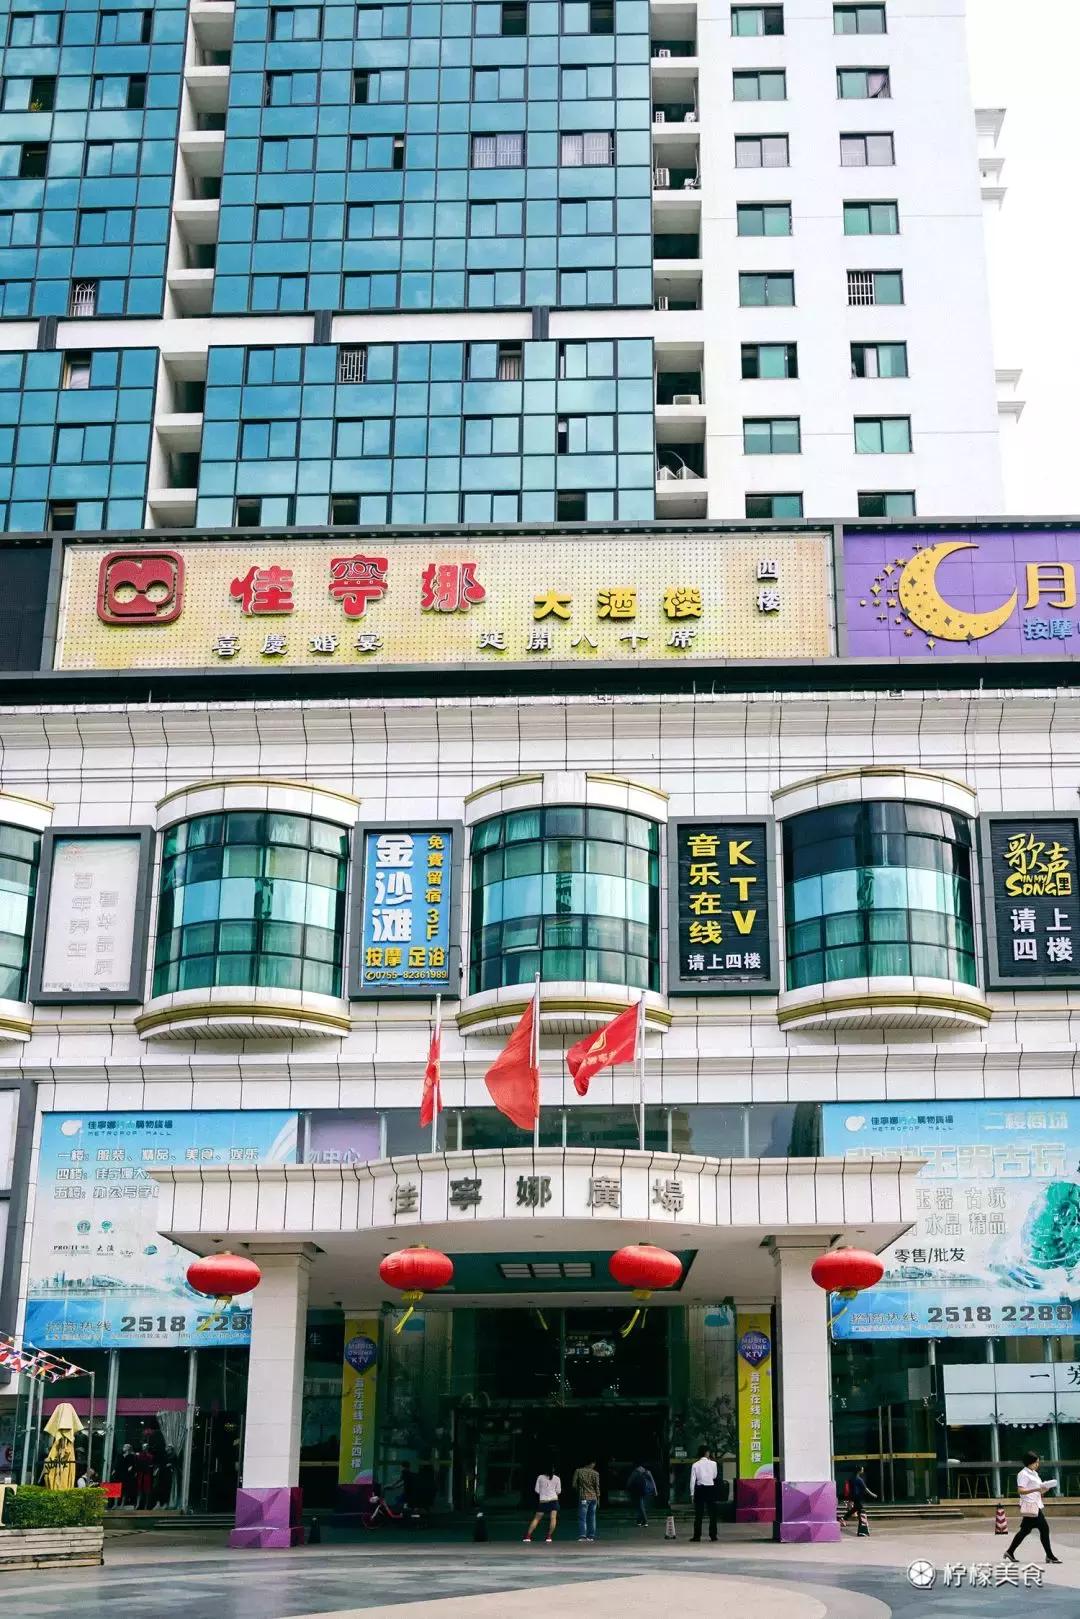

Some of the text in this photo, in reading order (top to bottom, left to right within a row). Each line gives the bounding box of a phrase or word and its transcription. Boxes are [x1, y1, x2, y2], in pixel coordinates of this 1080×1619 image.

[756, 560, 780, 612] 四楼
[1023, 562, 1077, 610] 月
[1023, 616, 1080, 640] 按摩
[212, 634, 384, 656] 喜慶婚宴
[372, 834, 414, 942] 金沙滩
[687, 833, 723, 945] 音乐在线
[729, 840, 757, 934] KTV
[1010, 908, 1072, 932] 请上
[365, 947, 445, 967] 按摩 足浴
[1013, 937, 1073, 962] 四楼
[688, 953, 761, 971] 请上四楼
[925, 1213, 1006, 1236] 水晶 精品
[894, 1248, 966, 1263] 零售/批发
[121, 1316, 186, 1332] 2518
[197, 1315, 252, 1331] 228
[928, 1306, 991, 1322] 2518
[1001, 1305, 1072, 1321] 2288
